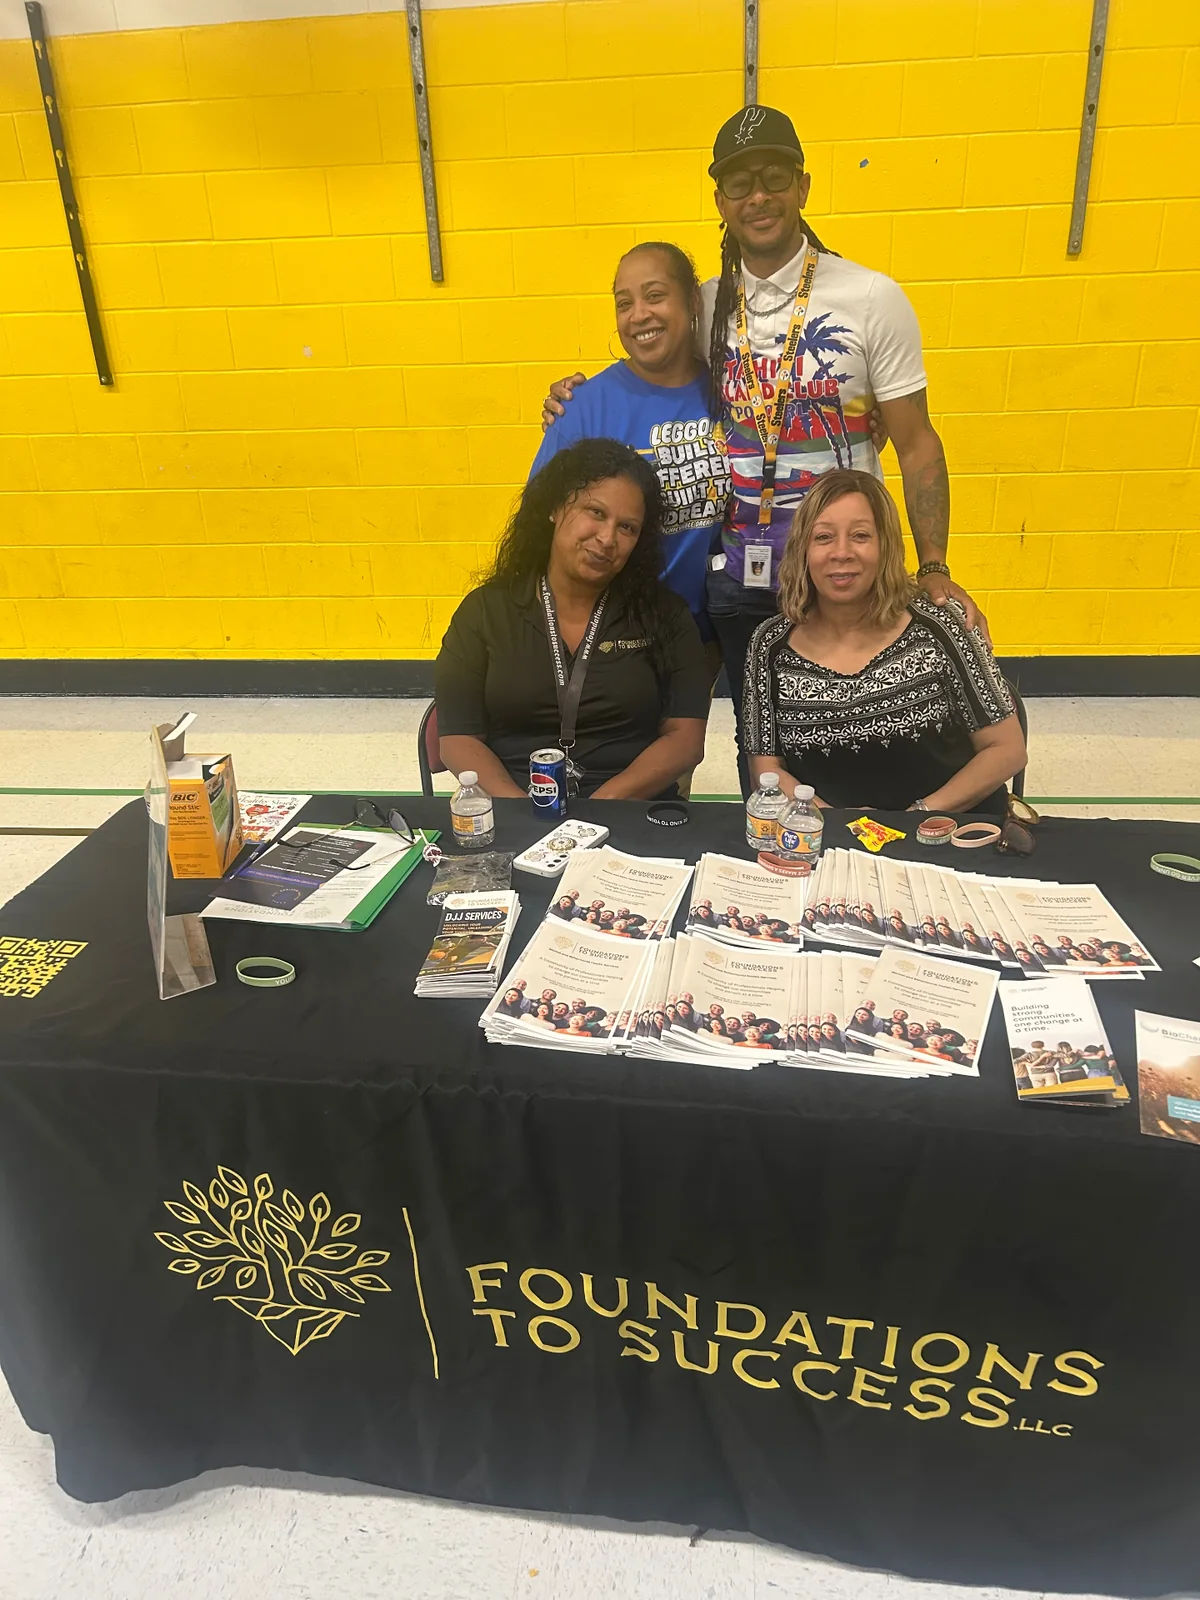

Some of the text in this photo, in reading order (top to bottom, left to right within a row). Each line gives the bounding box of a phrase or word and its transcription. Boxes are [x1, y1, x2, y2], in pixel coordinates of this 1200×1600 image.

[798, 262, 816, 299] Steelers
[736, 292, 745, 329] Steelers
[783, 323, 801, 362] Steelers
[723, 355, 804, 382] TAHII
[741, 351, 756, 390] Steelers
[770, 388, 787, 428] Steelers
[650, 417, 714, 446] LEGGO!
[657, 438, 716, 465] BUILT
[541, 575, 565, 686] www.foundationstosuccess.com
[532, 786, 557, 795] EPSI
[444, 910, 502, 922] DJJ SERVICES
[1013, 1013, 1076, 1022] communities
[467, 1262, 1104, 1396] FOUNDATIONS
[473, 1309, 1073, 1436] TO SUCCESS .LLC
